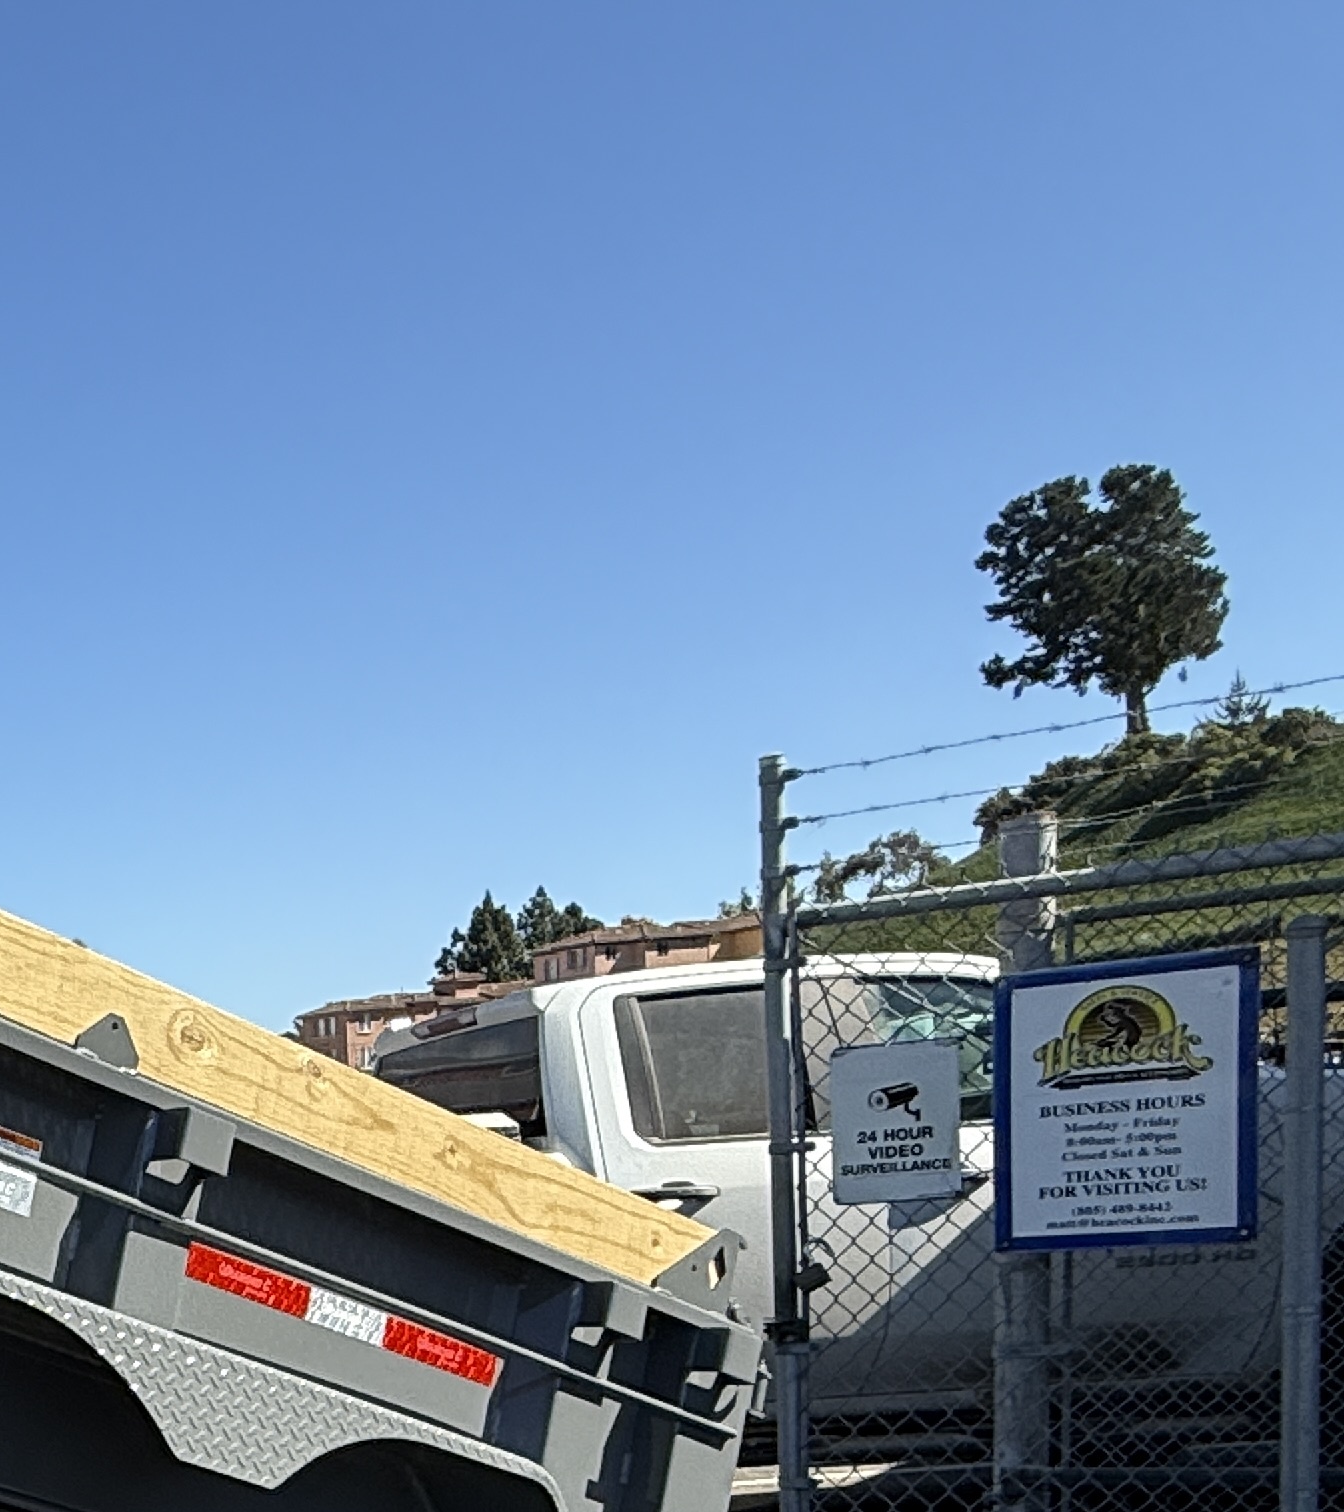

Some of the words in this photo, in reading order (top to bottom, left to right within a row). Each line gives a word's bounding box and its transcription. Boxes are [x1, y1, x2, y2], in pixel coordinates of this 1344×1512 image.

[1033, 1022, 1213, 1080] Heacock
[1039, 1100, 1131, 1119] BUSINESS
[1136, 1093, 1206, 1112] HOURS
[1064, 1121, 1119, 1133] Monday
[1133, 1116, 1181, 1128] Friday
[857, 1130, 877, 1143] 24
[883, 1125, 933, 1142] HOUR
[868, 1143, 924, 1159] VIDEO
[1062, 1150, 1108, 1161] Closed
[1111, 1148, 1133, 1159] Sat
[1137, 1146, 1150, 1157] &
[1154, 1145, 1182, 1155] Sun
[840, 1158, 952, 1176] SURVEILLANCE
[1064, 1167, 1132, 1183] THANK
[1137, 1164, 1181, 1179] YOU
[1039, 1186, 1078, 1199] FOR
[1082, 1180, 1171, 1197] VISITING
[1175, 1177, 1208, 1192] US!
